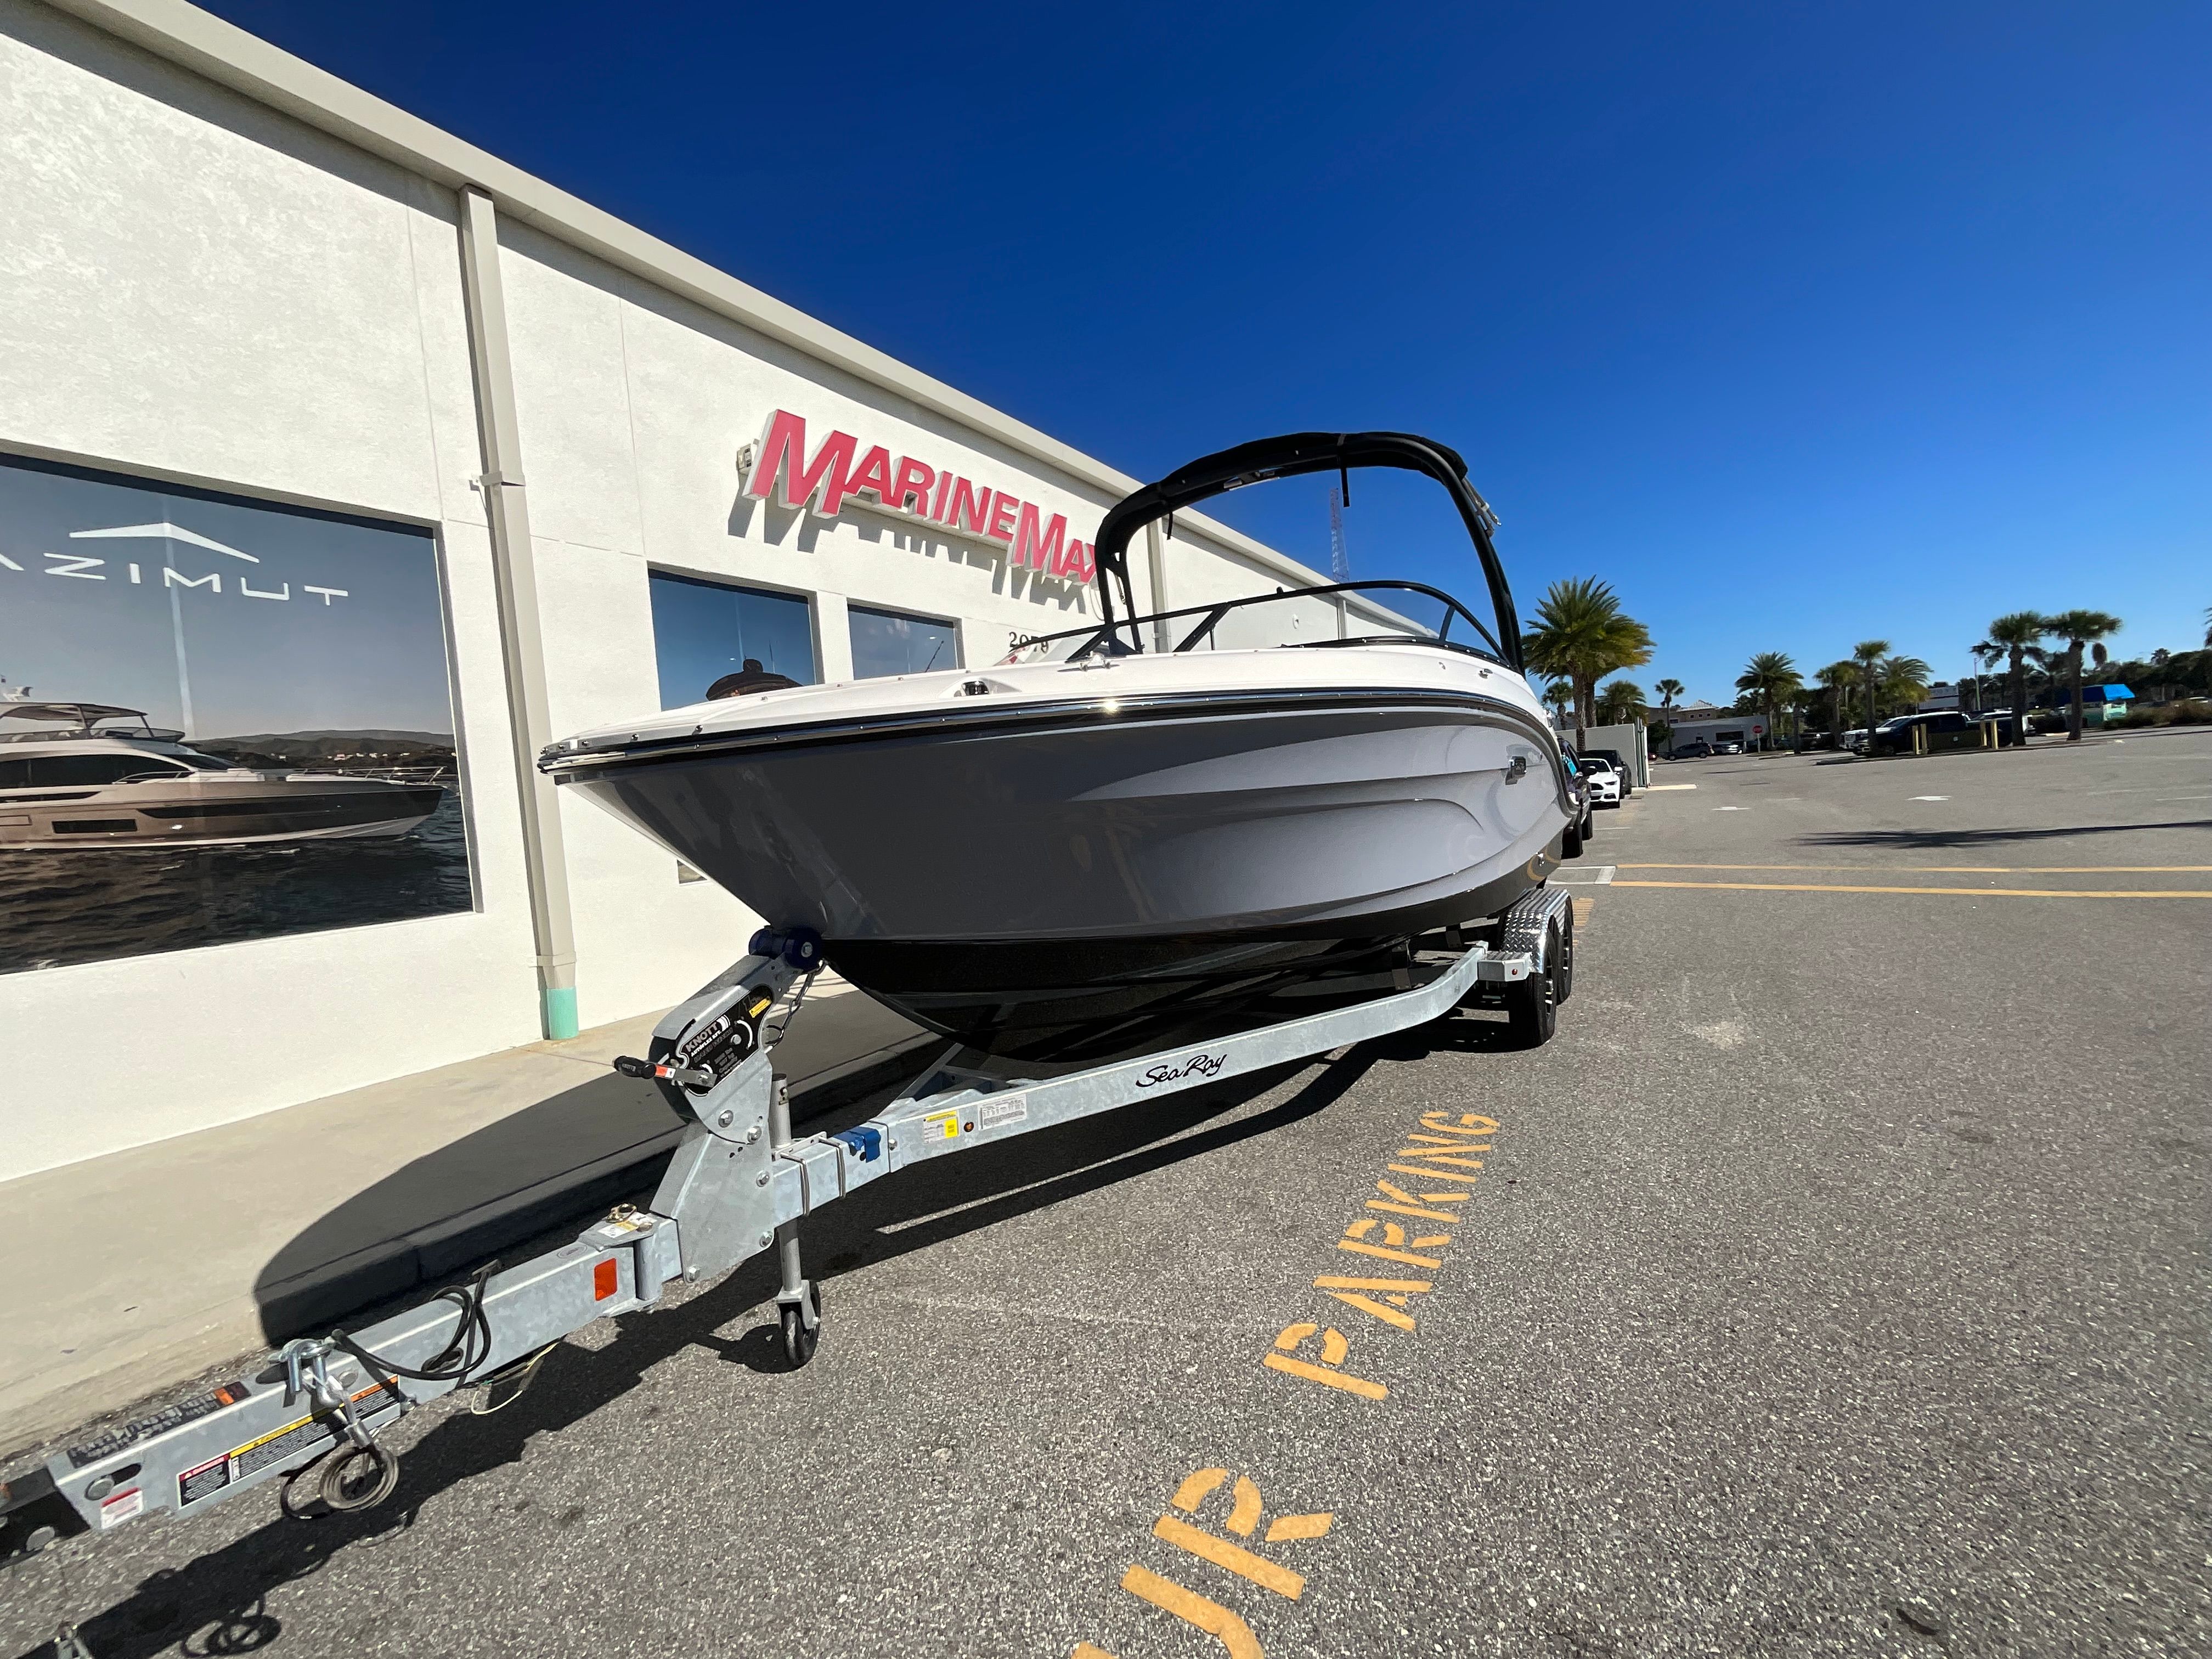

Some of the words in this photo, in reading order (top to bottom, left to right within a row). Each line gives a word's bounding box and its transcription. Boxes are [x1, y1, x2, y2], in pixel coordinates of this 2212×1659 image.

[685, 1022, 718, 1053] KNOTT
[1136, 1065, 1184, 1087] Sea
[1183, 1054, 1228, 1077] Ray
[1263, 1110, 1500, 1401] PARKING
